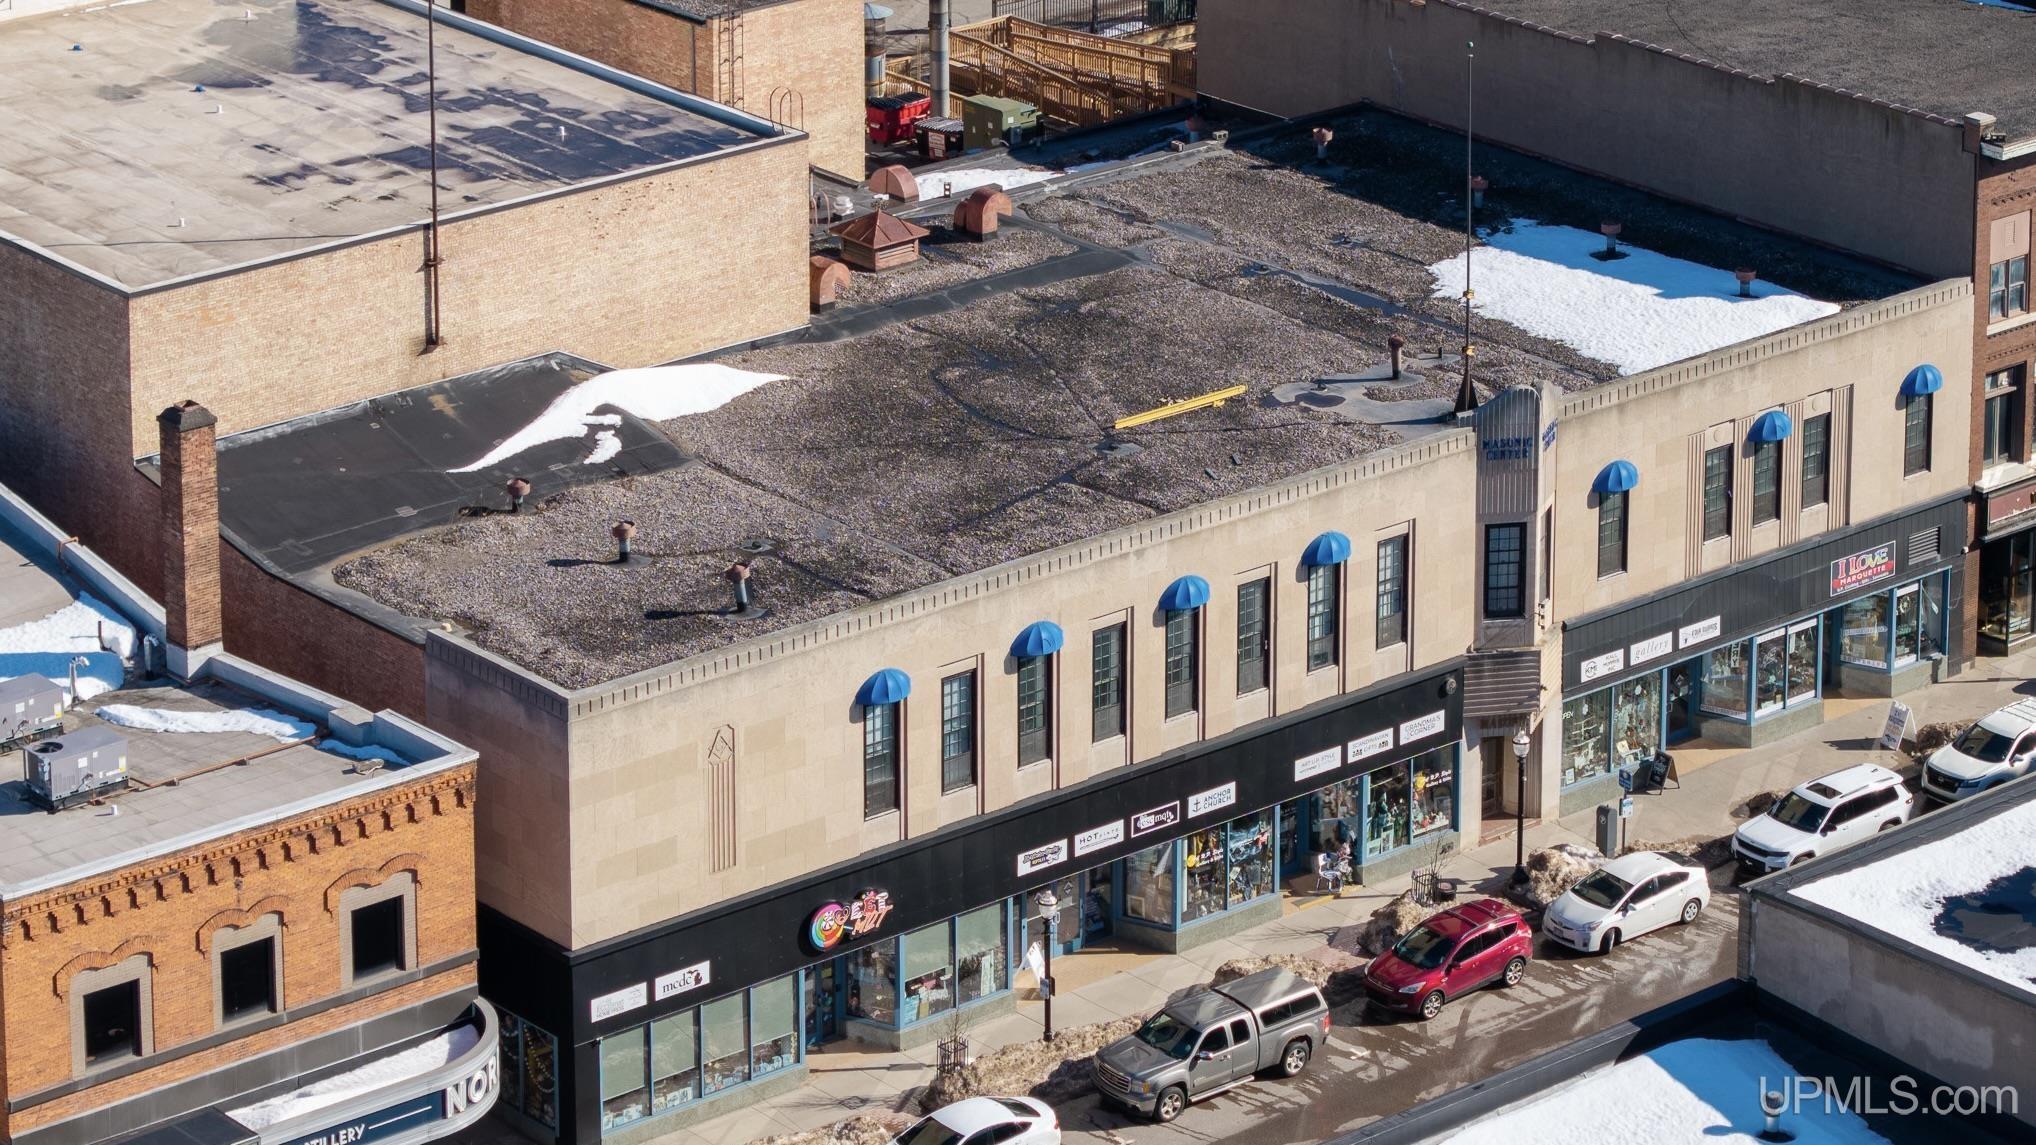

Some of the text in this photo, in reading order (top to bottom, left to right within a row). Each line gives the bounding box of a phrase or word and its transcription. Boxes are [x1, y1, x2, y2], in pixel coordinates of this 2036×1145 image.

[1482, 437, 1533, 449] MASONIC
[1838, 548, 1889, 578] I LOVE
[1840, 564, 1886, 586] MARQUETTE
[1203, 788, 1231, 803] ANCHOR
[1203, 795, 1232, 810] CHURCH
[662, 973, 693, 993] mcdc
